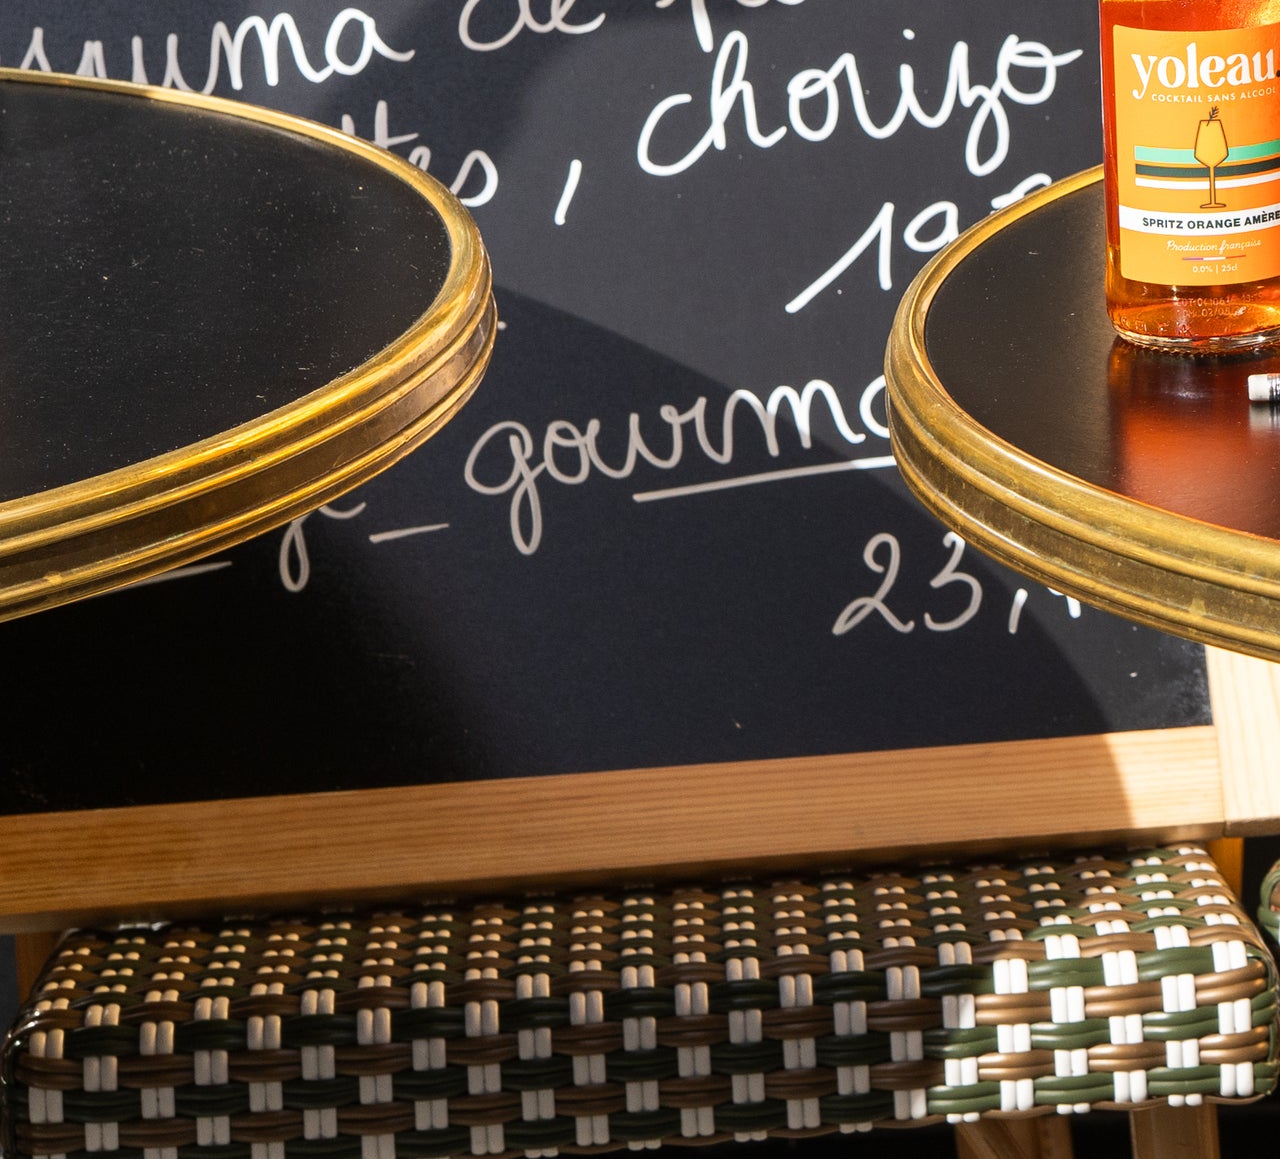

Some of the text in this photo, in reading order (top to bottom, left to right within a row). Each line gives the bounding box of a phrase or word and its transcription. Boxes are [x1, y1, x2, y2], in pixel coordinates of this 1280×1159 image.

[636, 29, 1084, 177] chorizo
[1151, 86, 1277, 104] COCKTAIL SANS ALCOOL
[1142, 216, 1184, 230] SPRITZ
[1187, 218, 1242, 230] ORANGE
[1166, 239, 1262, 255] Production française
[1192, 263, 1238, 274] 0.0% 25cl
